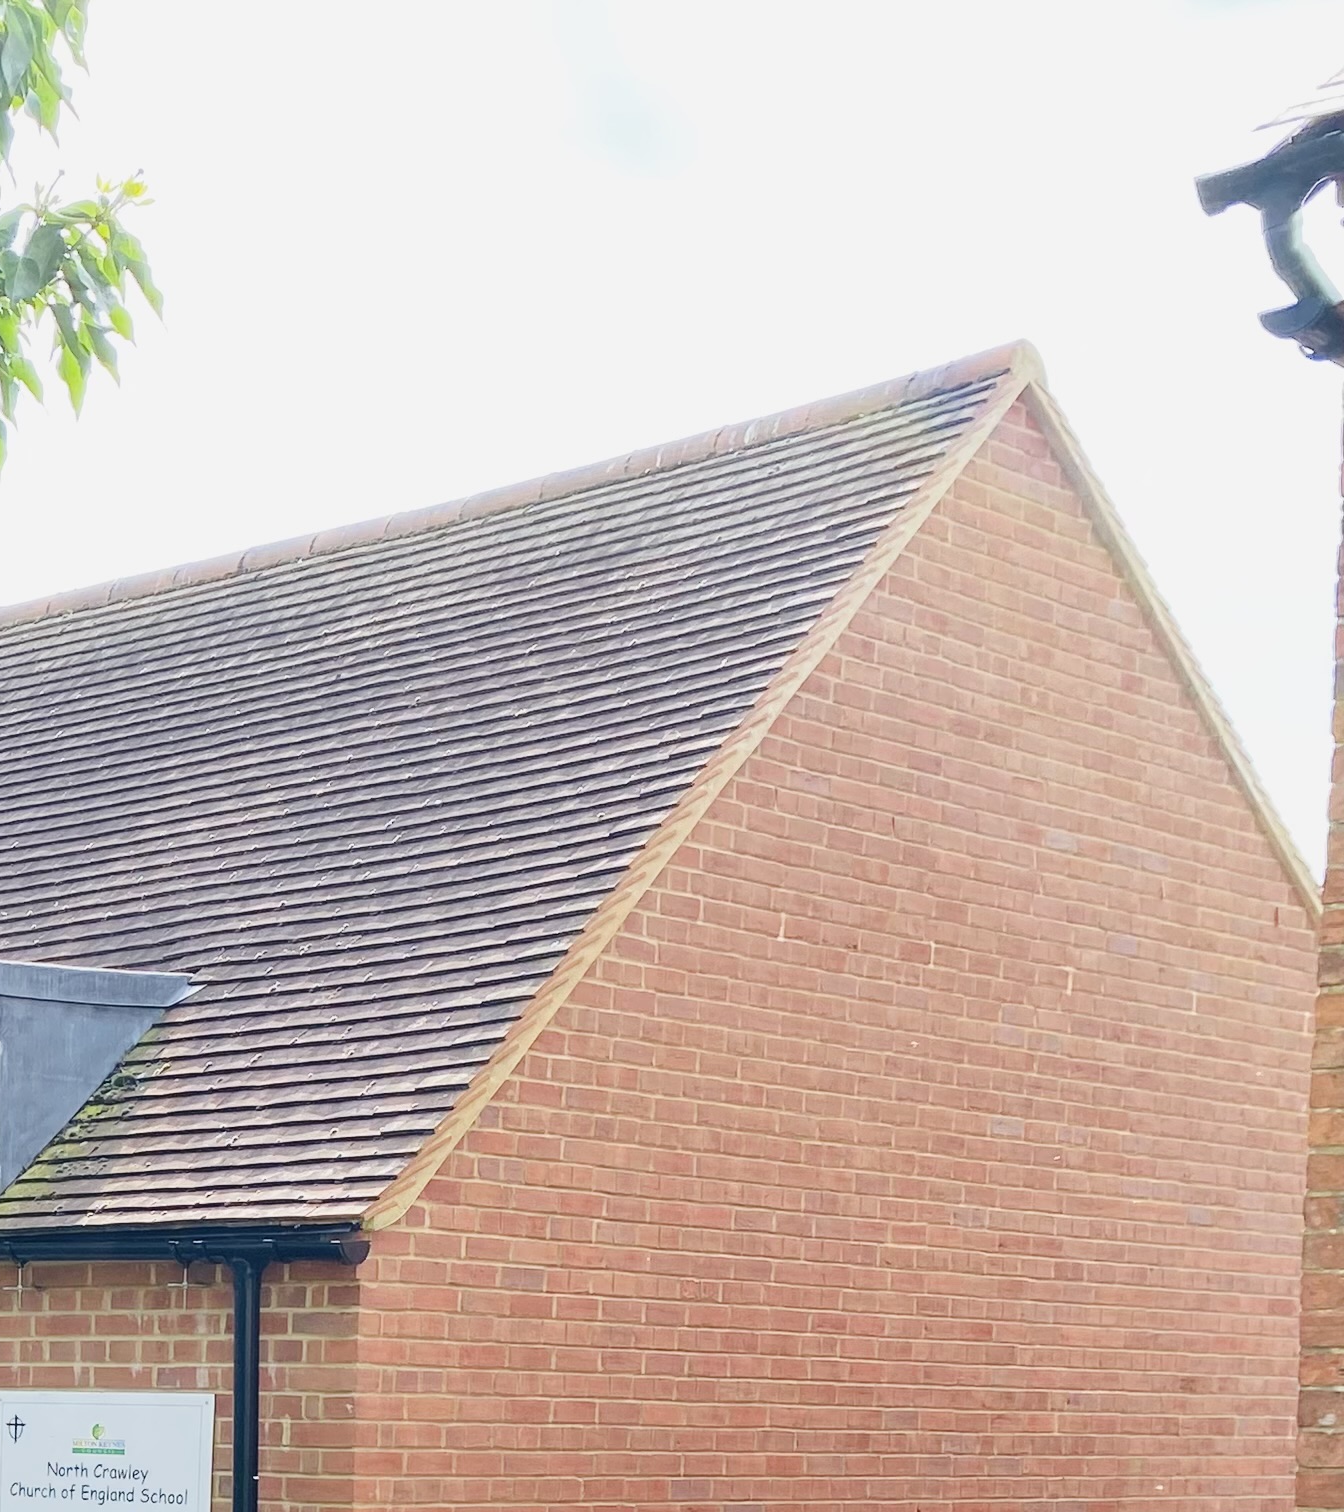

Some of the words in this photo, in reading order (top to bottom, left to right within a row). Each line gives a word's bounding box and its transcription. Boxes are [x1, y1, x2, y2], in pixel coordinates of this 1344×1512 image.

[47, 1462, 88, 1477] North
[93, 1464, 149, 1484] Crawley
[10, 1482, 56, 1499] Church
[61, 1484, 76, 1500] of
[81, 1485, 135, 1505] England
[140, 1488, 188, 1505] School
